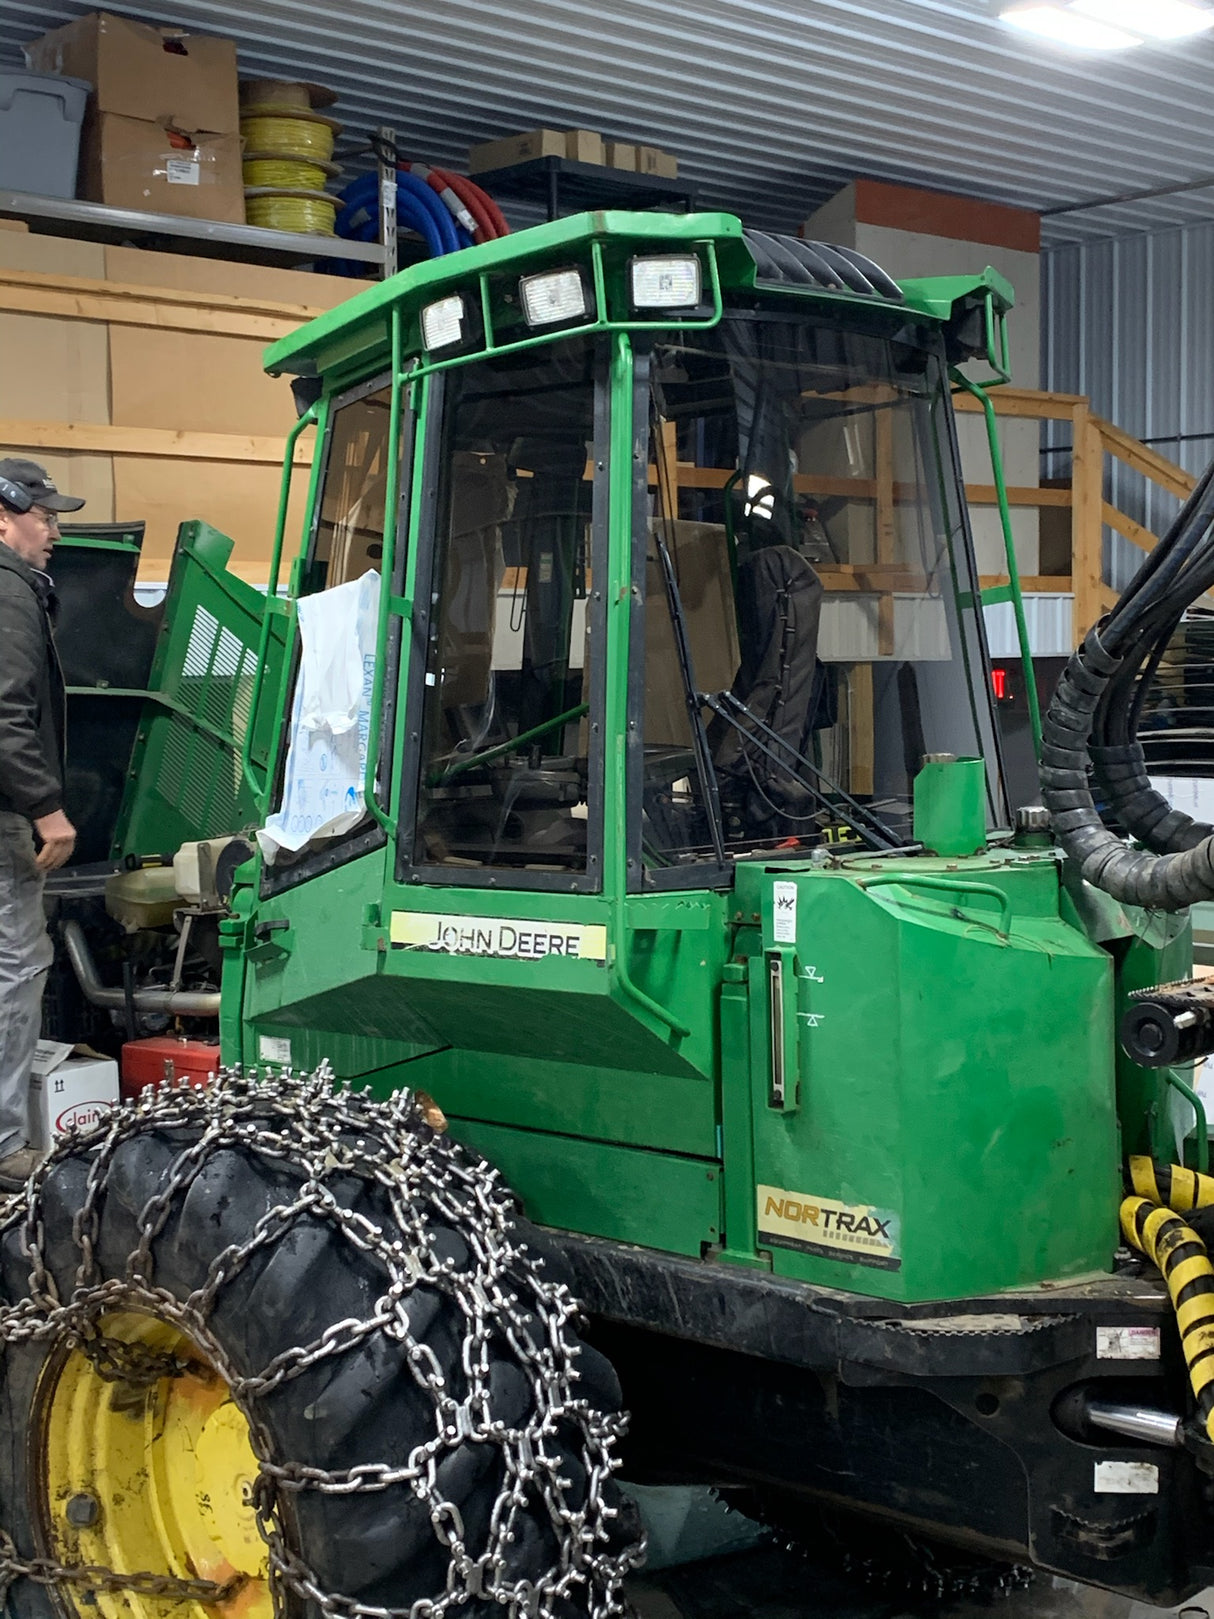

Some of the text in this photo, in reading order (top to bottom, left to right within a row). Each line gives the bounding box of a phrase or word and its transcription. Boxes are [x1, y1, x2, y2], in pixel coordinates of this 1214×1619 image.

[430, 921, 580, 957] JOHN DEERE
[764, 1196, 892, 1239] NORTRAX
